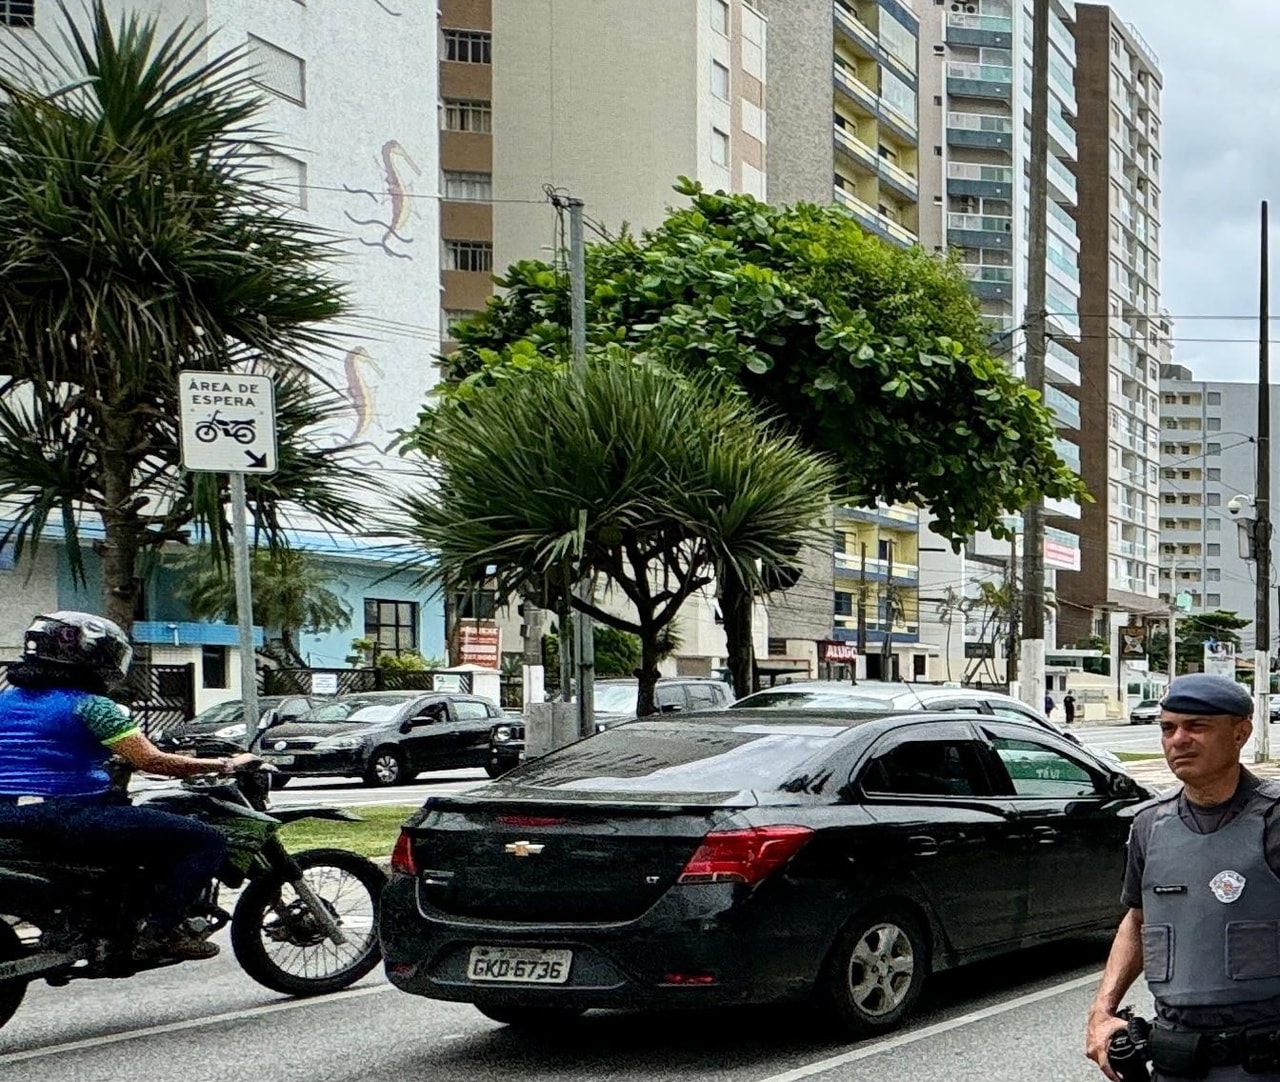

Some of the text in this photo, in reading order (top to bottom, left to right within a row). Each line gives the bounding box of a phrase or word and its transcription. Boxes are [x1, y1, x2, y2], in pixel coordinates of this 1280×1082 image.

[189, 378, 259, 394] ÁREA DE
[192, 394, 256, 407] ESPERA
